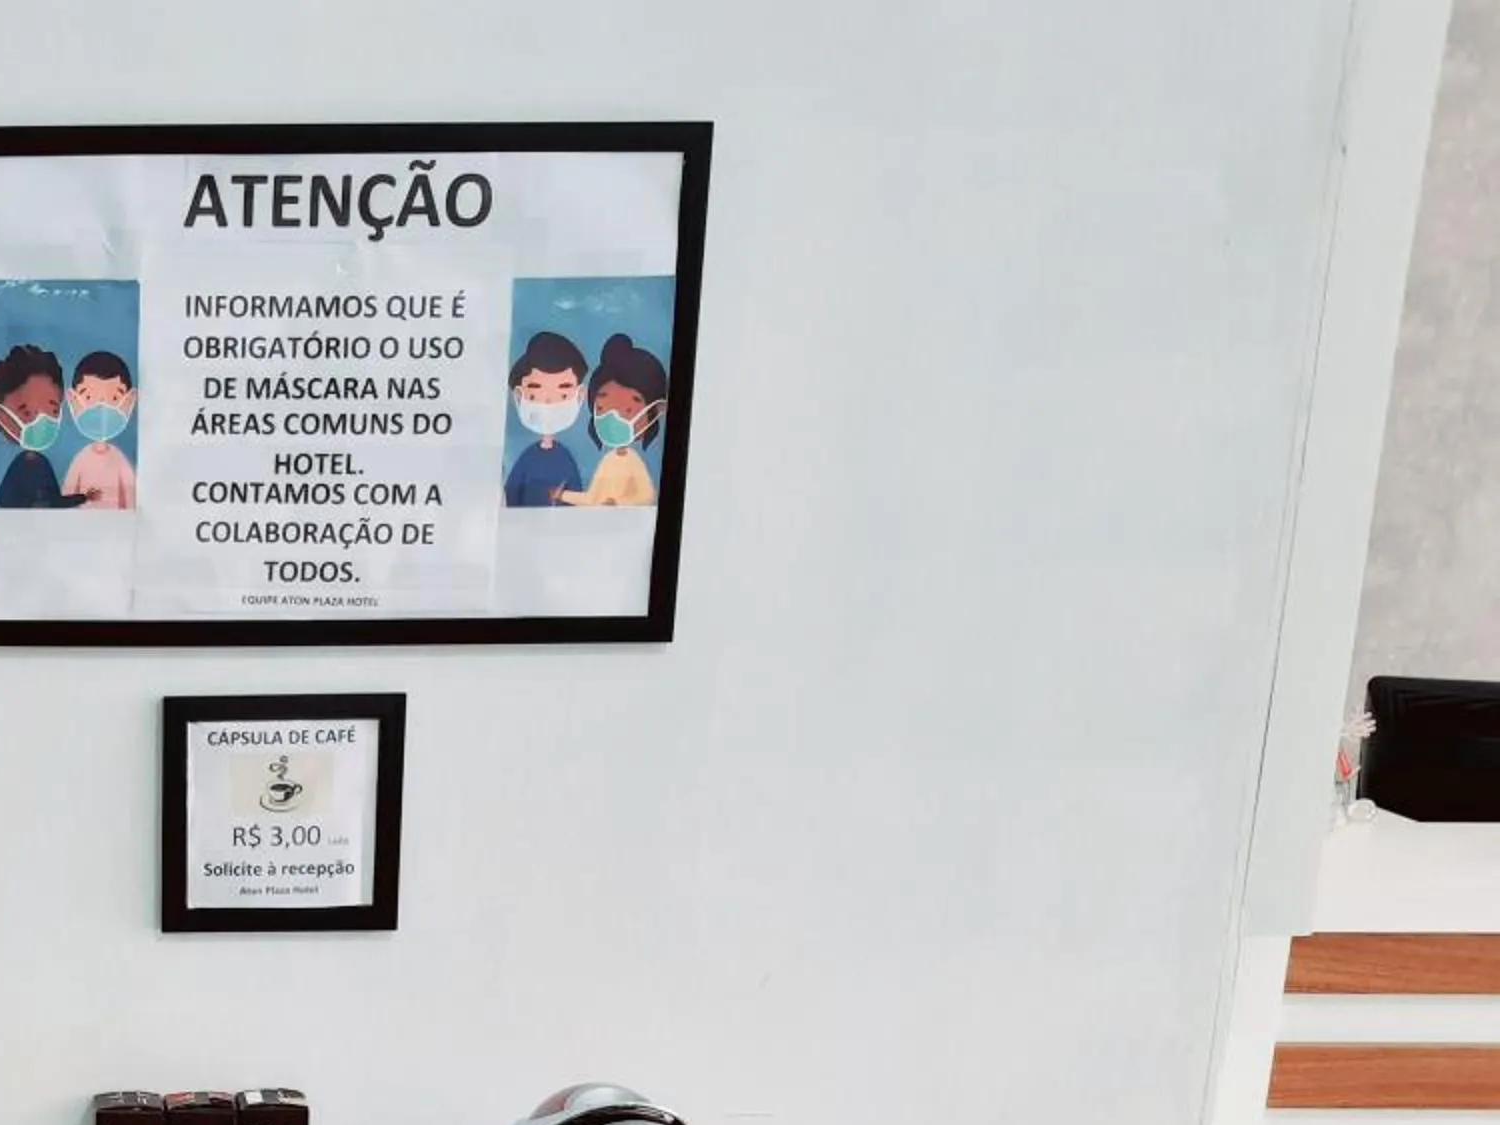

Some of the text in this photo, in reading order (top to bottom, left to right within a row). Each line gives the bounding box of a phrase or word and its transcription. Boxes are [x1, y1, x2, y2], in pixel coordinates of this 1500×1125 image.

[183, 159, 494, 242] ATENÇÃO
[184, 290, 466, 321] INFORMAMOS QUE É
[183, 331, 465, 359] OBRIGATÓRIO O USO
[203, 372, 441, 400] DE MÁSCARA NAS
[190, 407, 453, 435] ÁREAS COMUNS DO
[274, 453, 364, 475] HOTEL.
[192, 482, 443, 506] CONTAMOS COM A
[195, 517, 435, 550] COLABORAÇÃO DE
[263, 561, 361, 583] TODOS.
[313, 597, 344, 606] PLAZA
[346, 597, 378, 607] HOTEL
[207, 725, 357, 746] CÁPSULA DE CAFÉ
[233, 824, 321, 848] R$ 3,00
[203, 859, 355, 877] Solicite à recepção
